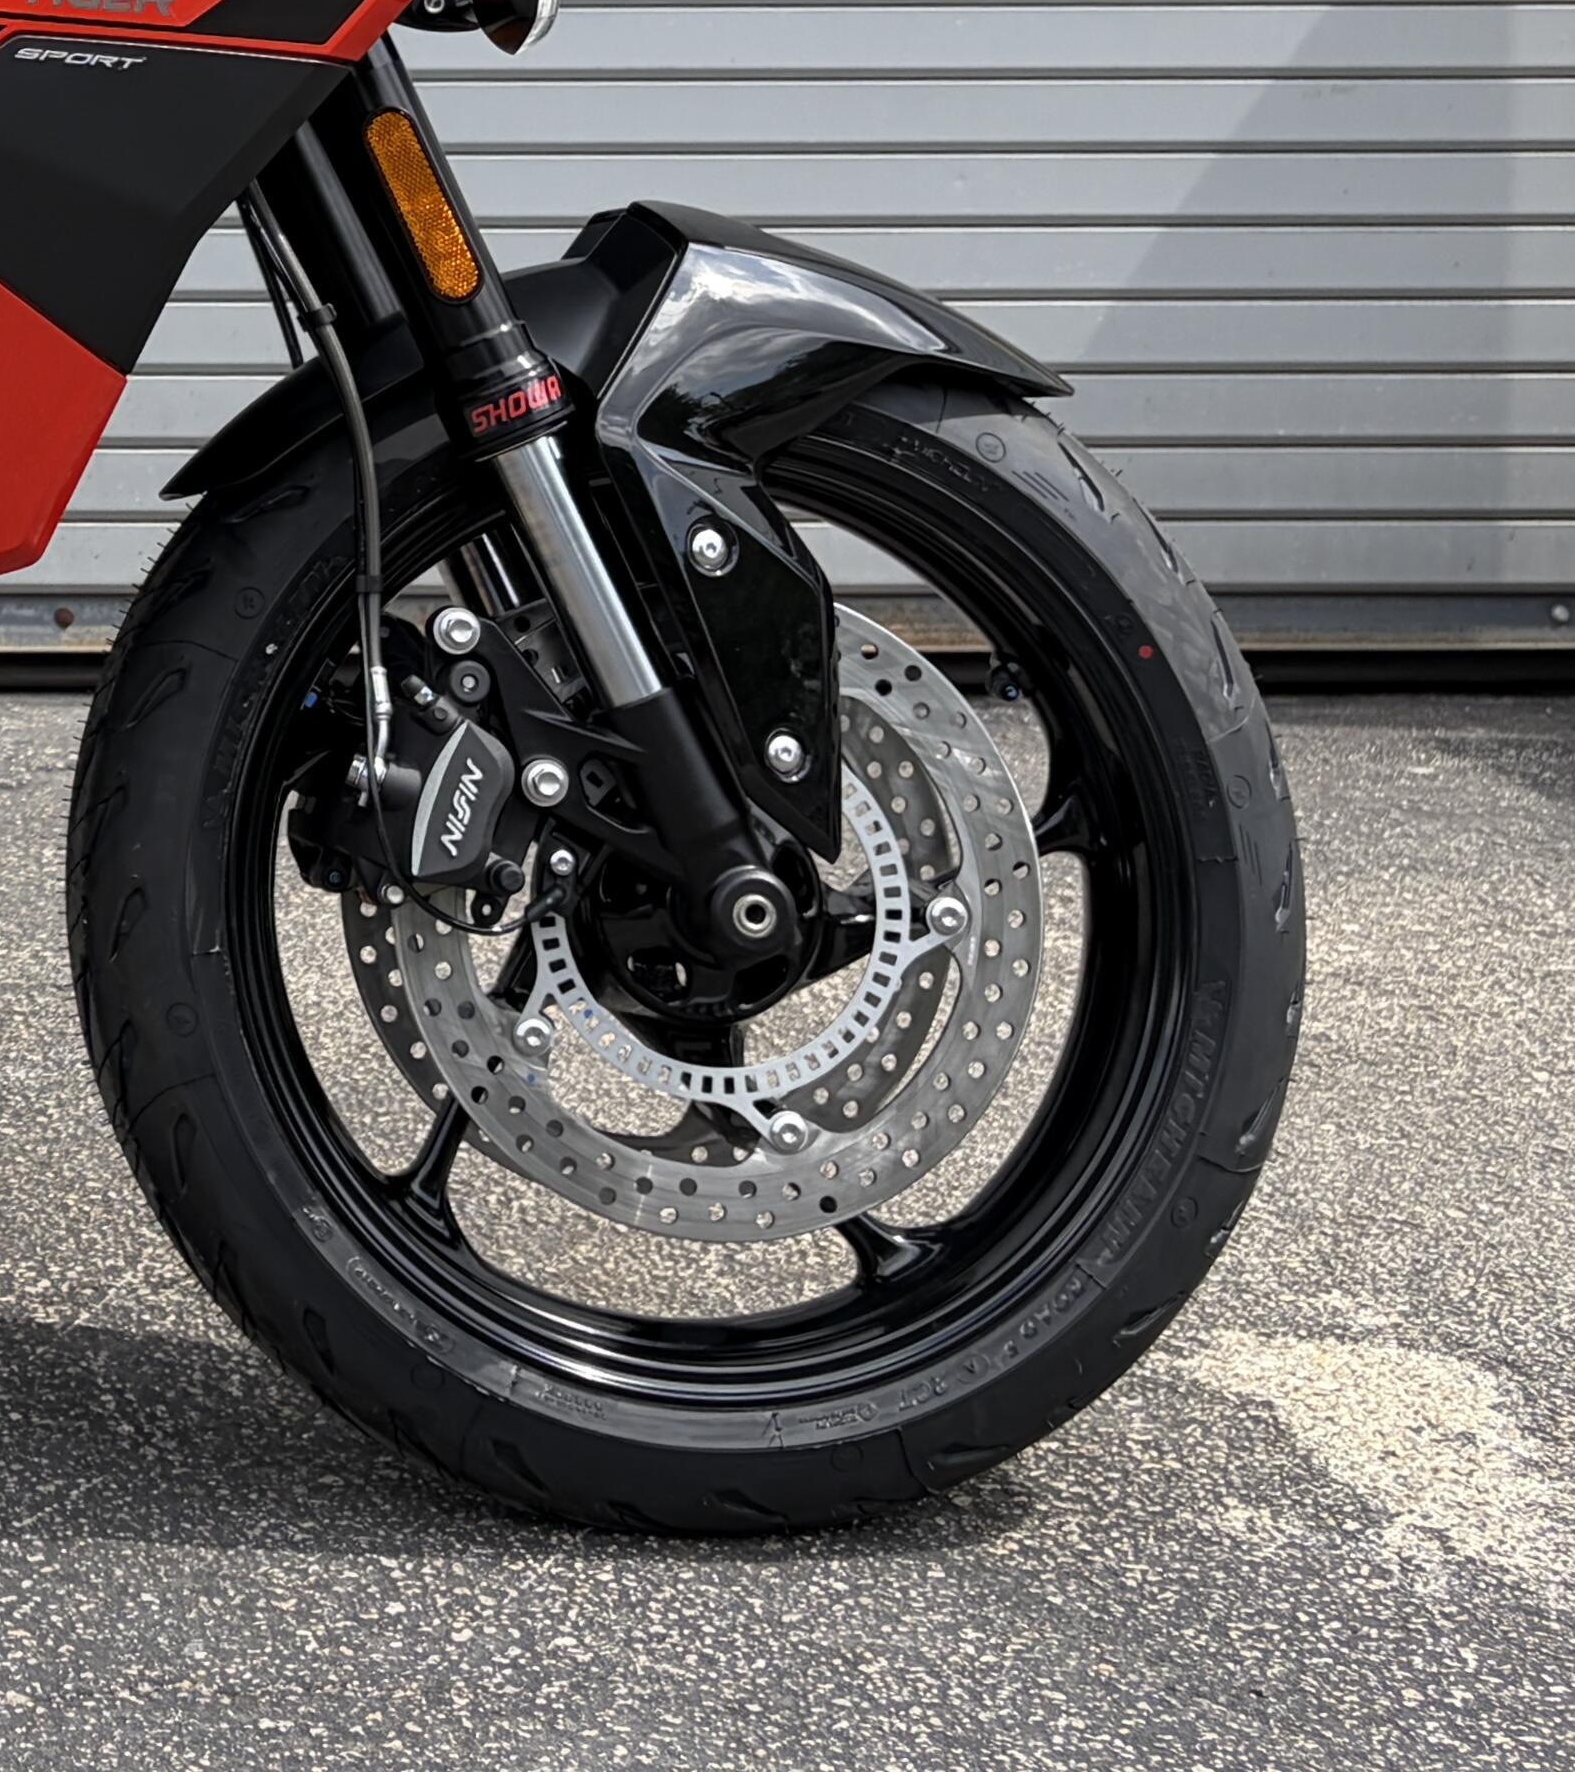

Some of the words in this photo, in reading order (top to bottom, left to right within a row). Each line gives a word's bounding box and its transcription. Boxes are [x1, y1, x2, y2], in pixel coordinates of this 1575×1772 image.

[13, 46, 147, 70] SPORT
[470, 374, 562, 434] SHOWA
[440, 756, 485, 858] NISSIN
